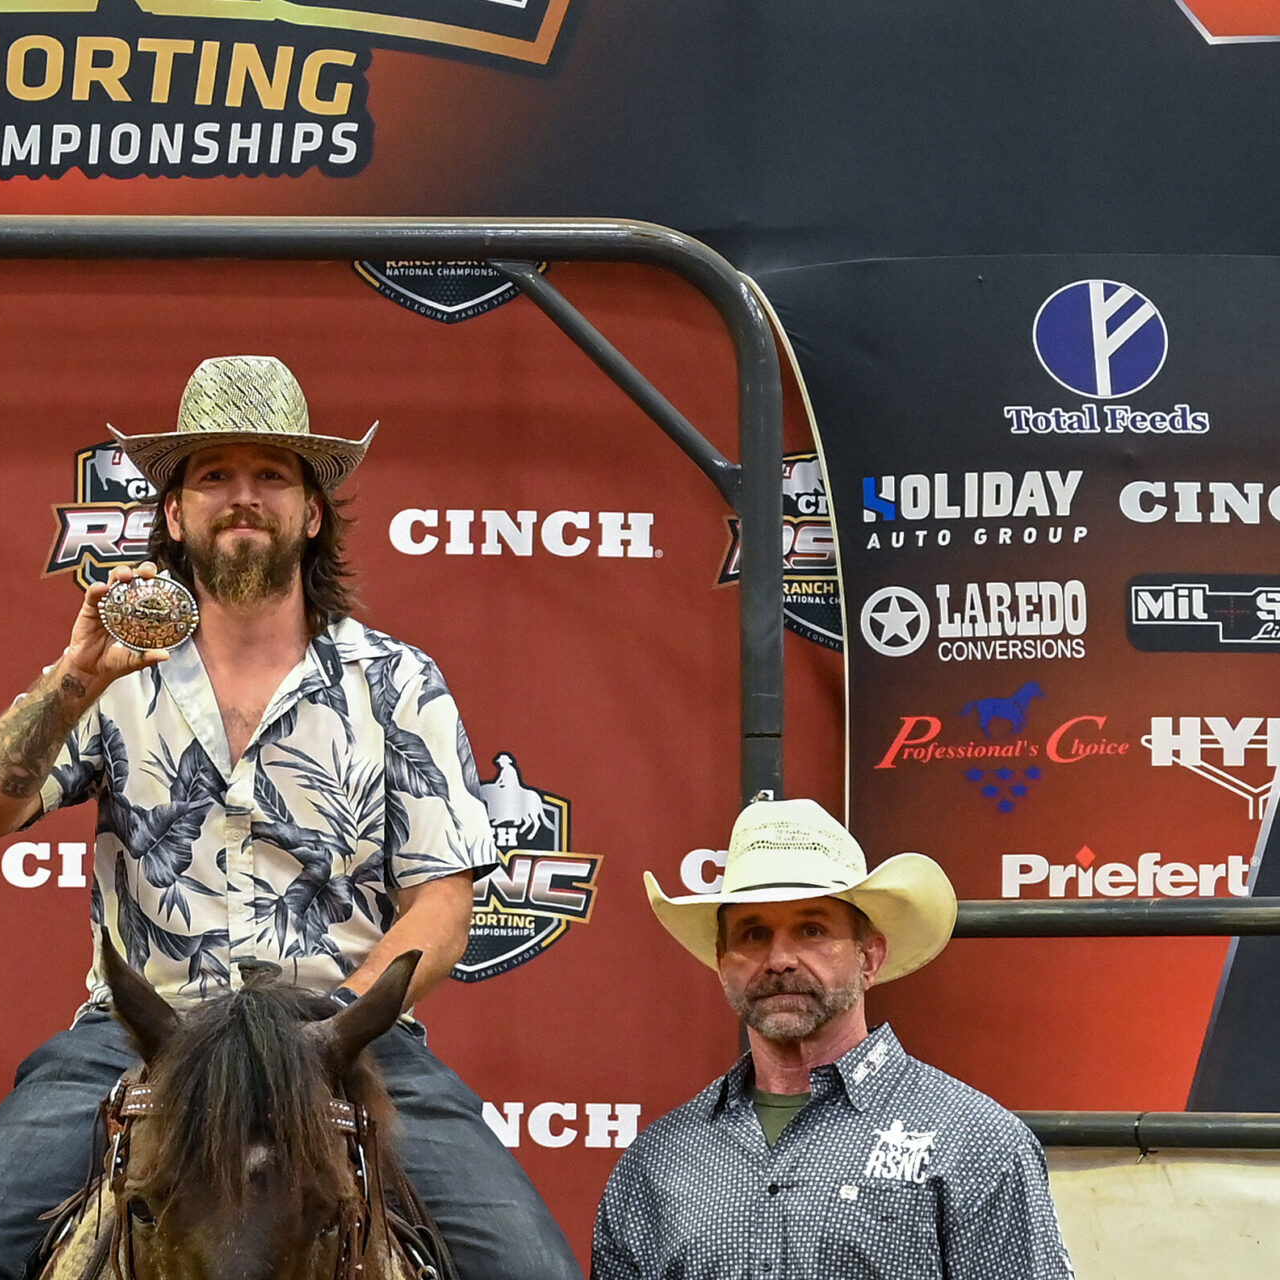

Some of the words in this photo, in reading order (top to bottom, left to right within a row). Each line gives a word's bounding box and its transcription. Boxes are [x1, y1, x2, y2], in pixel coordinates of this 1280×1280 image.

[385, 268, 434, 276] NATIONAL
[1004, 404, 1099, 433] Total
[1104, 404, 1209, 433] Feeds
[863, 471, 1083, 522] HOLIDAY
[1119, 481, 1280, 524] CIN
[388, 508, 654, 558] CINCH
[867, 529, 952, 550] AUTO
[974, 526, 1088, 546] GROUP
[935, 580, 1088, 638] LAREDO
[1137, 589, 1208, 619] Mil
[938, 638, 1086, 662] CONVERSIONS
[874, 716, 1039, 769] Professional's
[1046, 715, 1130, 764] Choice
[1001, 846, 1250, 898] Priefert
[864, 1149, 930, 1184] RSNC
